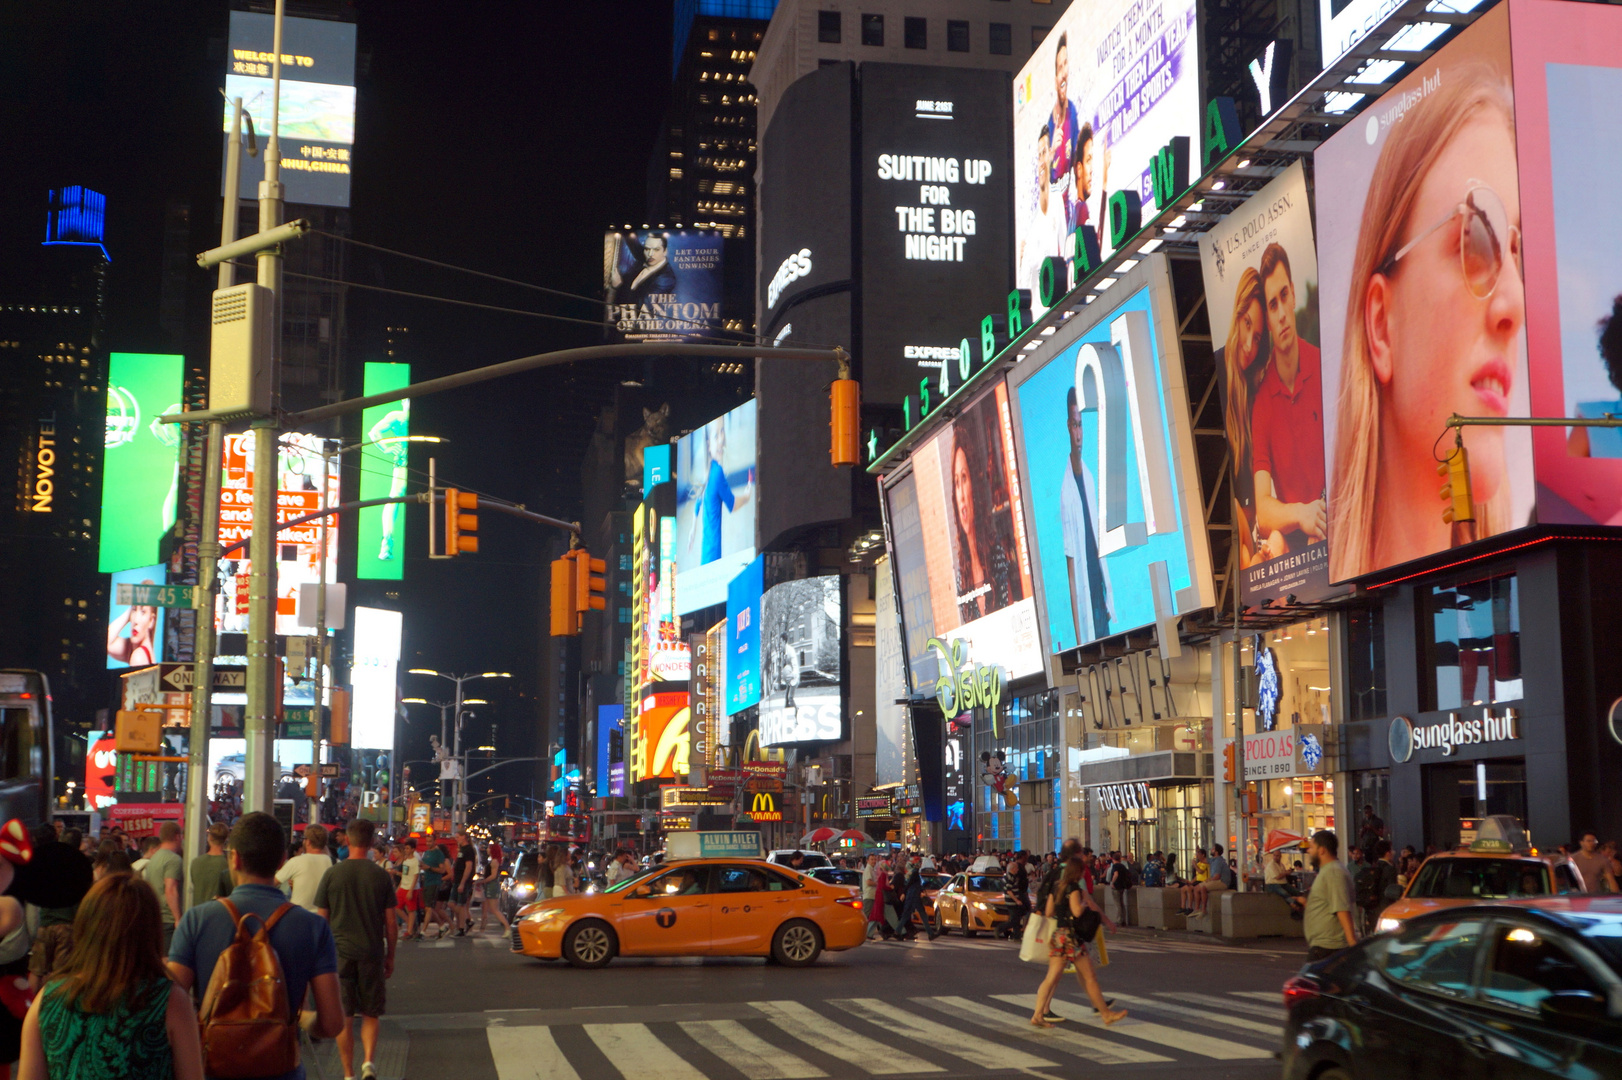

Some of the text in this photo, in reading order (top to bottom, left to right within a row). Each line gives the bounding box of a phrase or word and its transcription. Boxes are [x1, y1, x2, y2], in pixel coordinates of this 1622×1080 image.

[233, 49, 314, 68] WELCOE TO
[1097, 22, 1121, 67] WATCH
[1098, 13, 1188, 129] WATCH THEM ALL YEAR
[1113, 46, 1126, 79] FOR
[1380, 68, 1441, 130] sunglass hut
[1110, 111, 1122, 143] ON
[280, 158, 350, 174] NHUI,CHINA
[877, 153, 992, 184] SUITING UP
[920, 185, 950, 205] FOR
[895, 206, 976, 235] THE BIG
[1226, 192, 1293, 254] U.S. POLO ASSN.
[903, 40, 1278, 432] 1540 BROADWAY
[905, 234, 966, 262] NIGHT
[1242, 228, 1278, 260] SINCE 1890
[606, 302, 720, 321] PHANTOM
[648, 293, 677, 304] THE
[616, 320, 711, 331] OF THE OPERA
[904, 345, 961, 360] EXPRES
[1075, 312, 1158, 558] 21
[31, 410, 56, 513] NOVOTEL
[1249, 546, 1328, 582] LIVE AUTHENTICAL
[135, 587, 192, 604] W 45 St
[696, 644, 706, 752] PALACE
[1077, 645, 1178, 731] FOREVER
[292, 711, 301, 720] 45
[759, 704, 841, 747] EXPRESS
[1413, 708, 1516, 756] sunglass hut
[1246, 735, 1293, 760] POLO AS
[1244, 763, 1290, 776] SINCE 1890
[363, 791, 379, 808] R
[1097, 782, 1151, 811] FOREVER 21
[123, 818, 154, 831] JESUS
[413, 805, 426, 831] tkts
[704, 834, 757, 844] ALVIN AILEY
